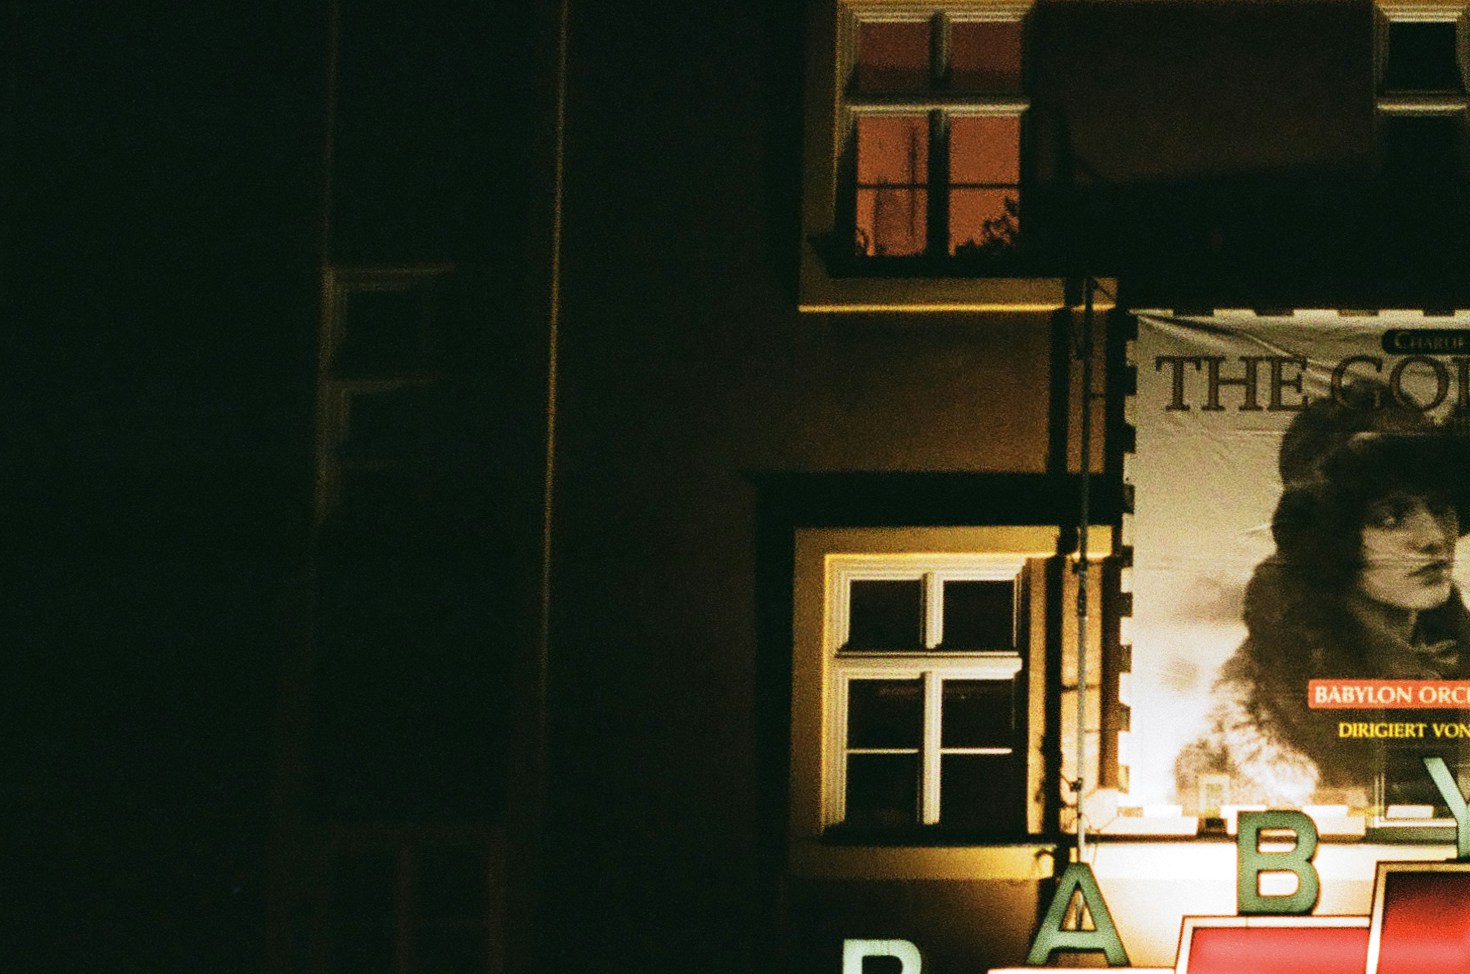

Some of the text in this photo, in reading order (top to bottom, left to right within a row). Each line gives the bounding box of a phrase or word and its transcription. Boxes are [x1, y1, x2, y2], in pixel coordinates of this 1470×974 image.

[1155, 355, 1309, 411] THE
[1314, 685, 1412, 704] BABYLON
[1338, 722, 1427, 739] DIRIGIERT
